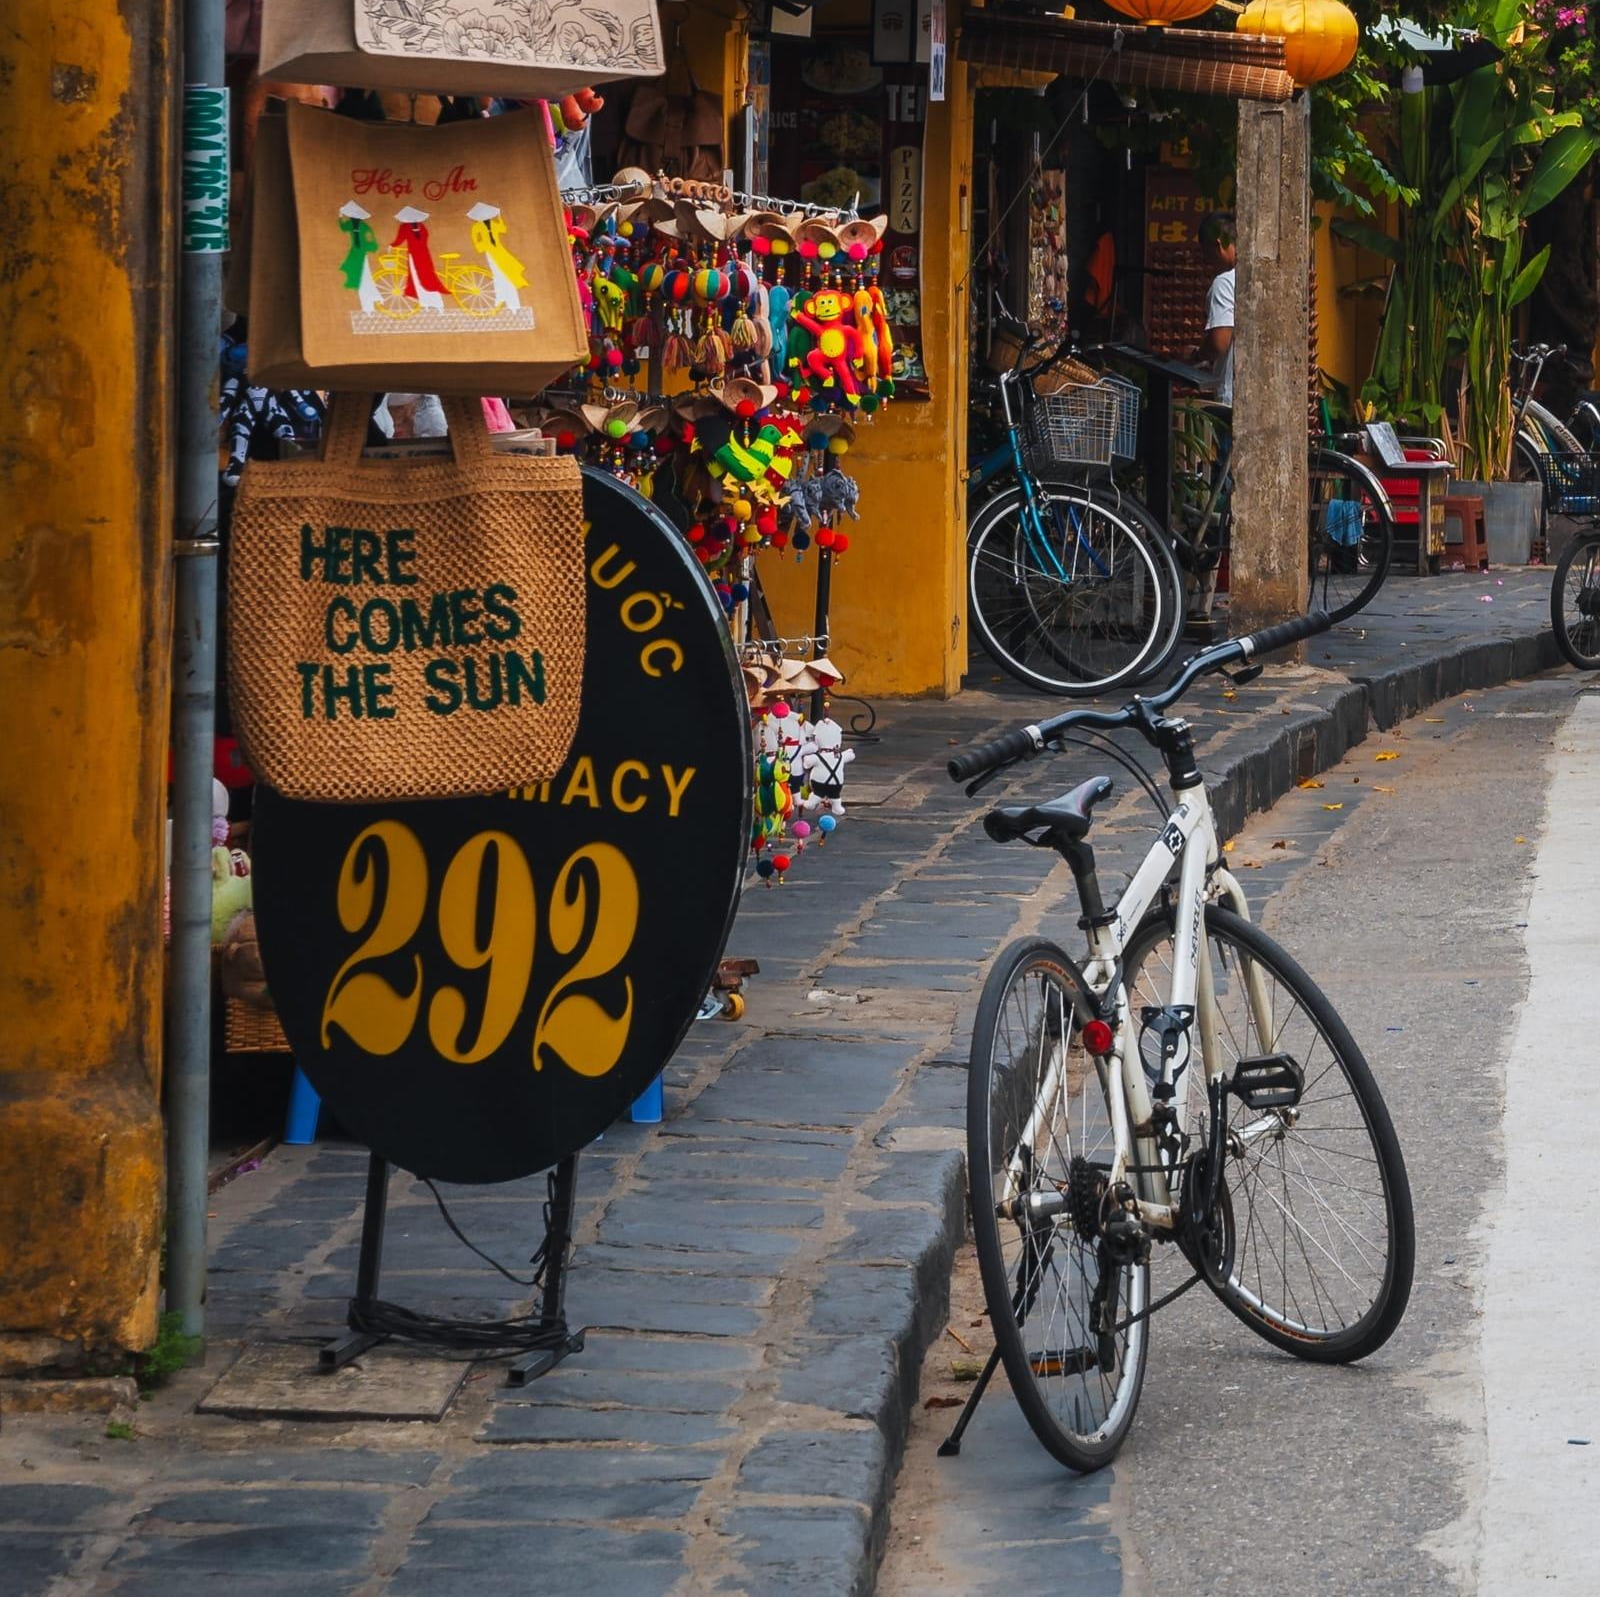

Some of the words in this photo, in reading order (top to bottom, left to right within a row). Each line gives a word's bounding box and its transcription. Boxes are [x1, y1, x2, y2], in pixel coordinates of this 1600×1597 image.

[351, 168, 413, 199] Hội
[423, 165, 478, 201] An
[901, 150, 913, 230] PIZZA
[299, 523, 418, 585] HERE
[325, 583, 522, 654] COMES
[583, 521, 685, 678] UỐC
[296, 662, 397, 720] THE
[424, 648, 546, 716] SUN
[321, 819, 640, 1077] 292
[1190, 888, 1201, 969] CHEVROLET
